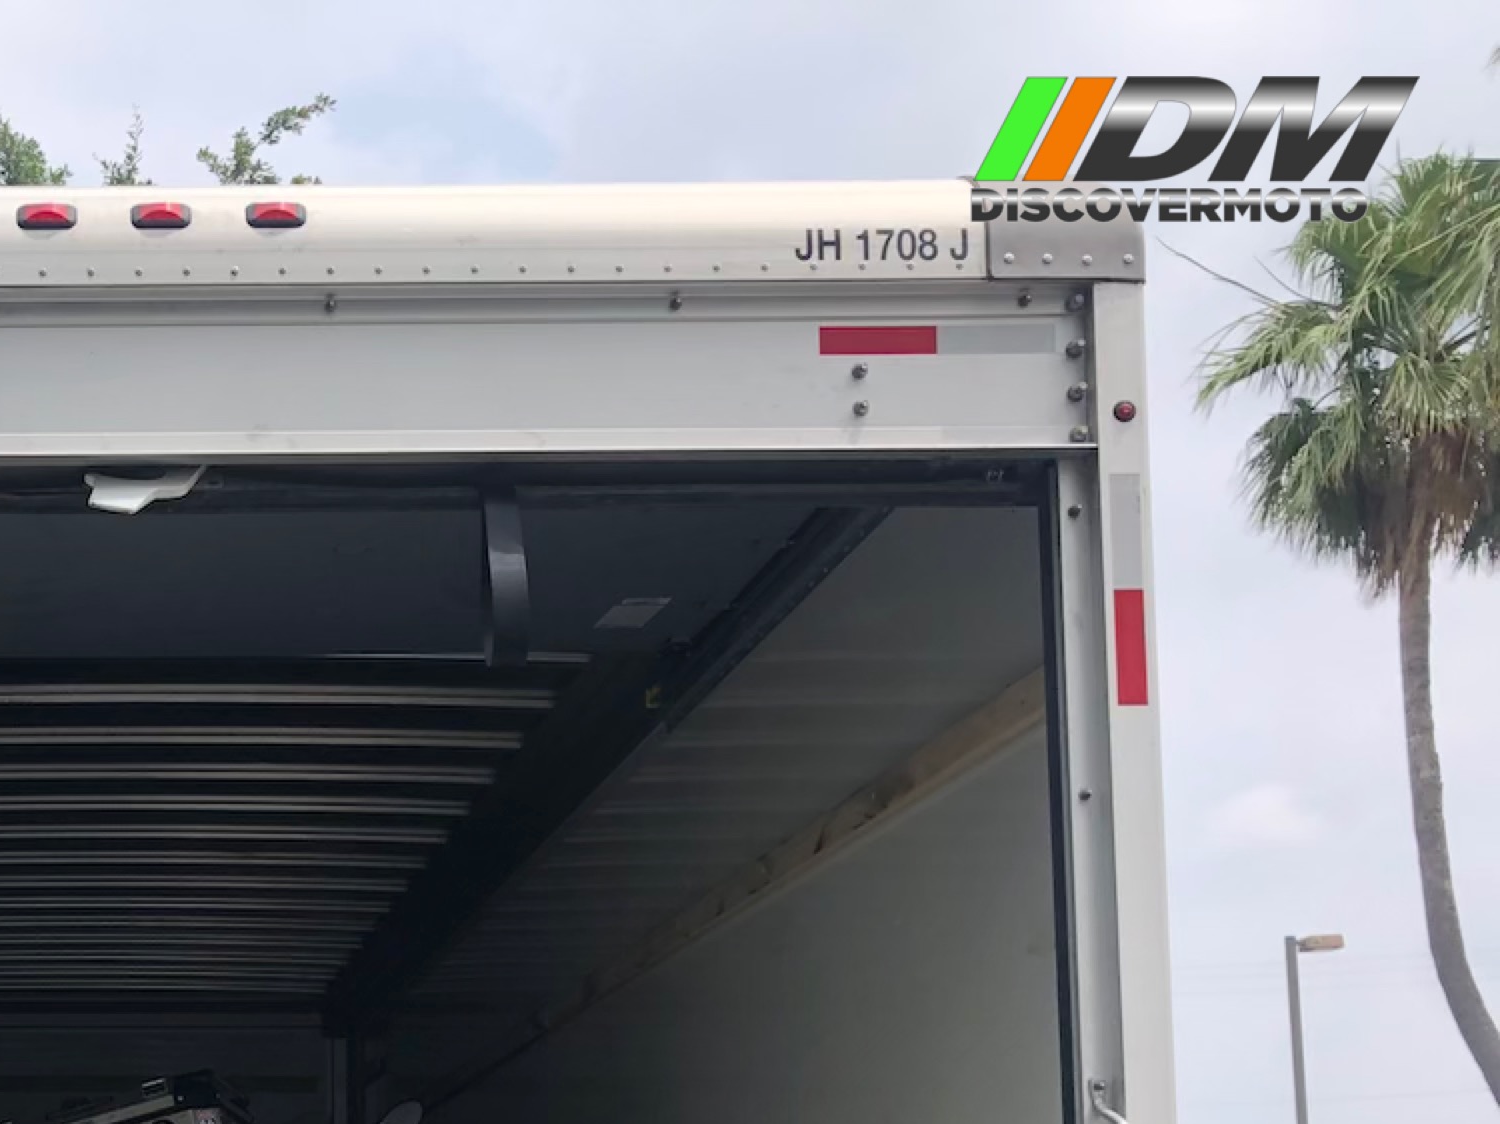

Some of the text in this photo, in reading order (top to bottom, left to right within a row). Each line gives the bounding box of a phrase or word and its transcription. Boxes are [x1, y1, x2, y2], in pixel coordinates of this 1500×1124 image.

[795, 228, 969, 261] JH 1708 J
